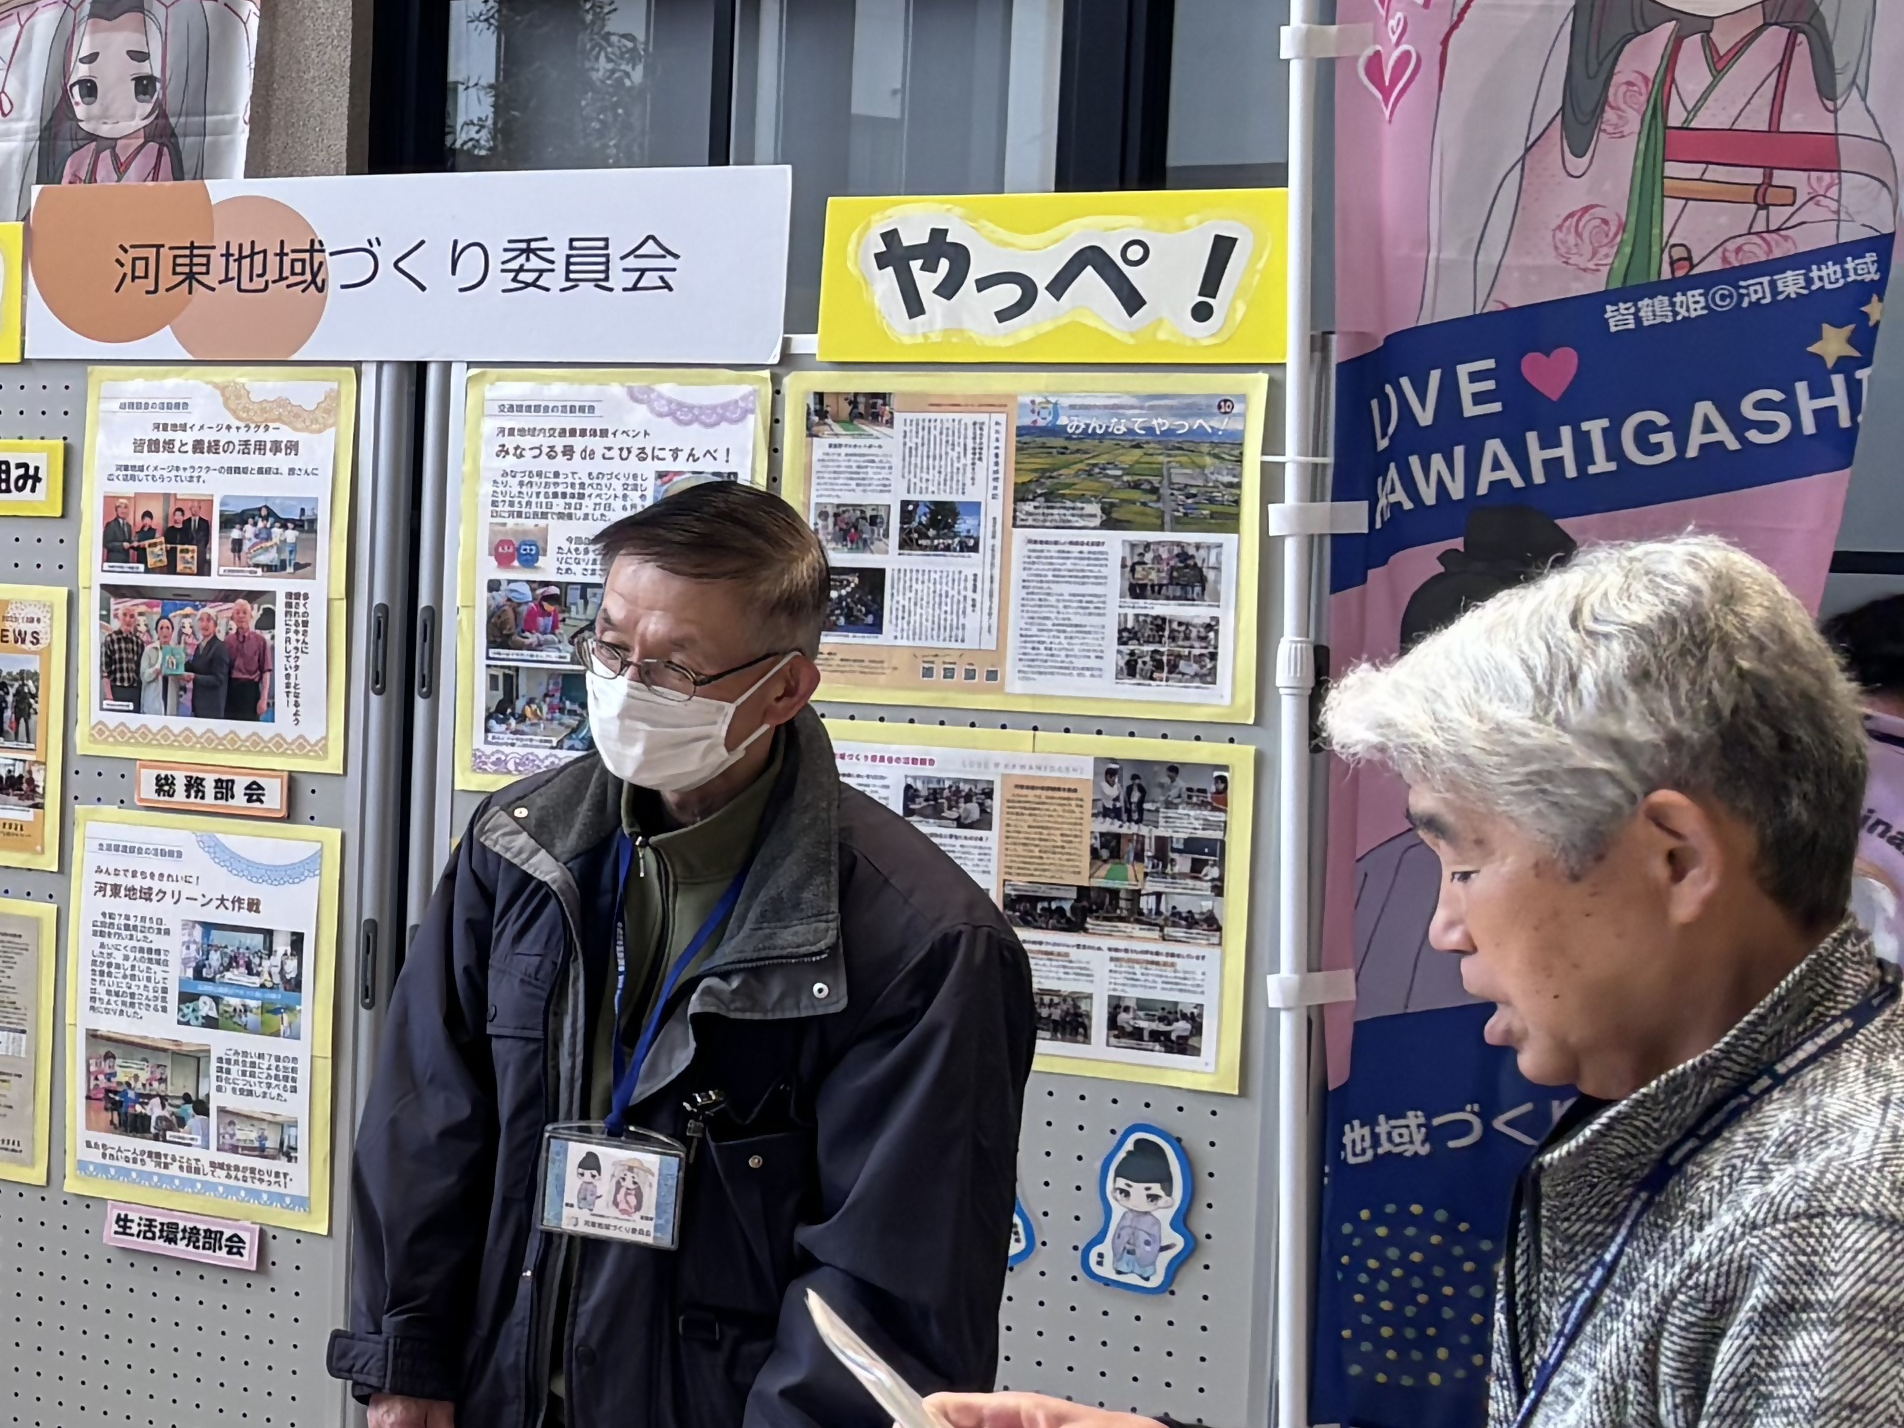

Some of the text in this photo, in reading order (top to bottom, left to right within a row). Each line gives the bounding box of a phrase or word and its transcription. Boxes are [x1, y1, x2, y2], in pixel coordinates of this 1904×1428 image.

[113, 234, 681, 296] 河東地域づくり委員会
[494, 443, 576, 461] みなづる号
[579, 444, 596, 462] de
[154, 773, 267, 805] 総務部会
[93, 881, 262, 914] 河東地域クリーン大作戦
[112, 1212, 248, 1258] 生活環境部会
